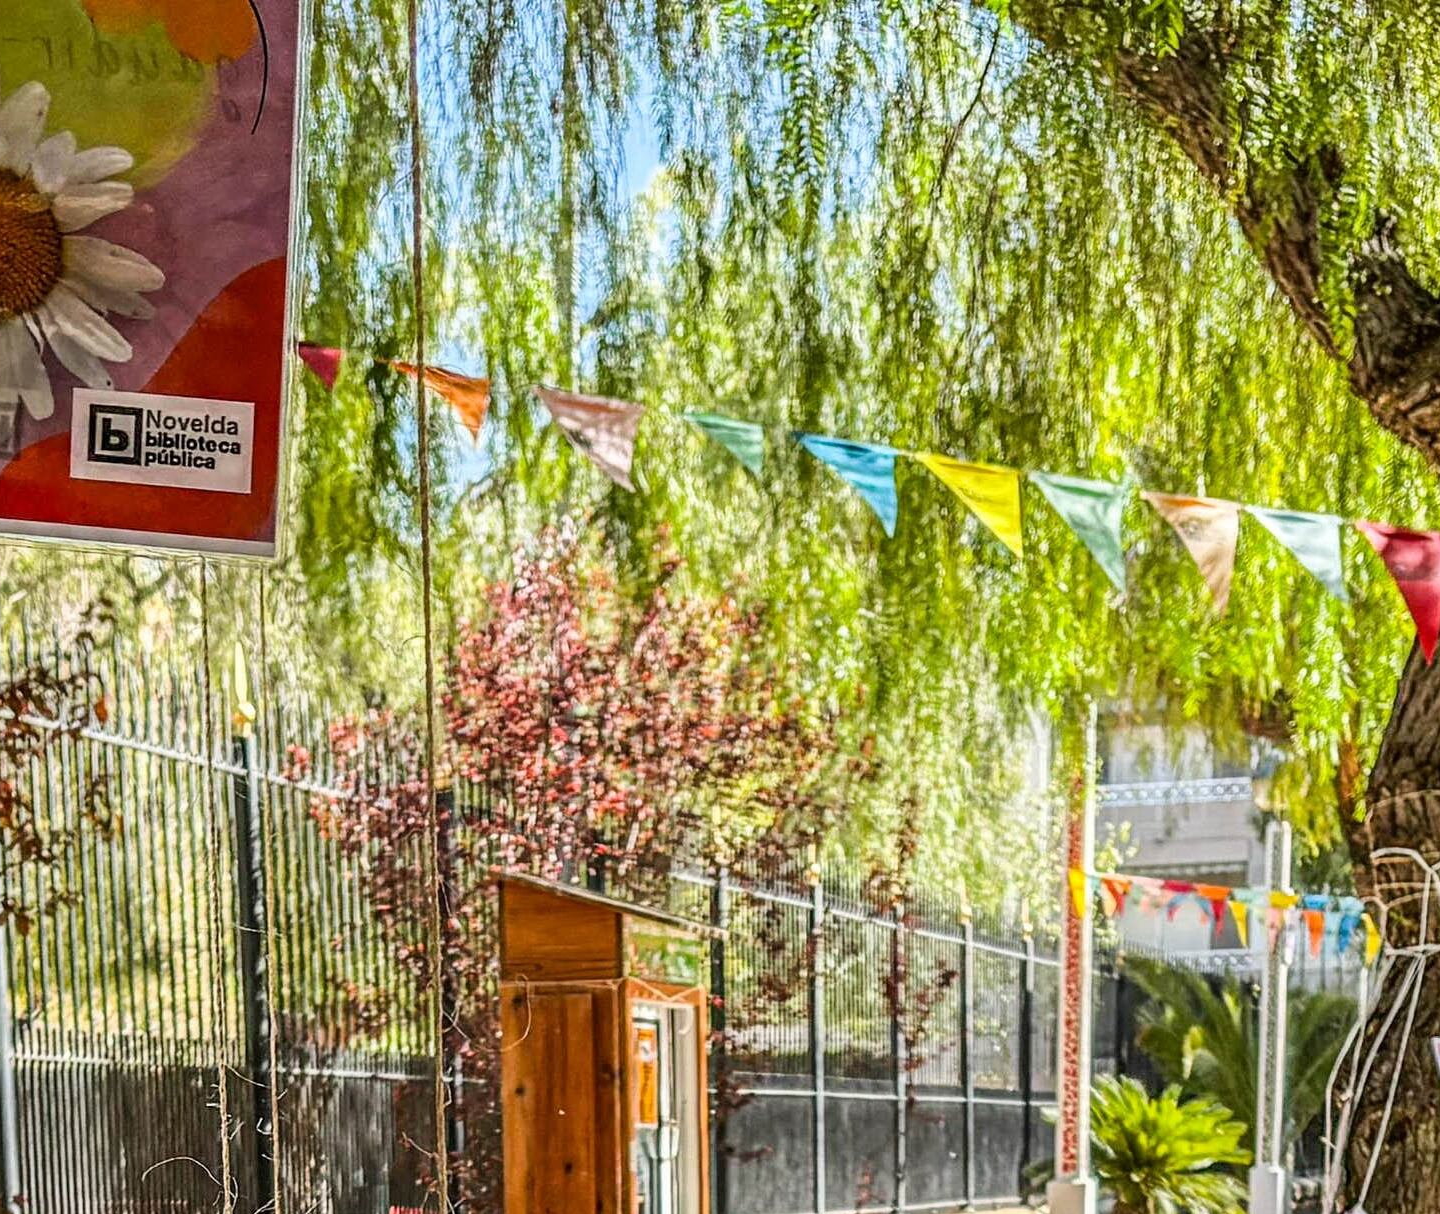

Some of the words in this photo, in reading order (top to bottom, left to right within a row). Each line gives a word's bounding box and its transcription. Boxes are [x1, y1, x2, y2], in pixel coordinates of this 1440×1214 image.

[145, 410, 239, 435] Novelda
[145, 433, 242, 455] biblioteca
[144, 449, 217, 471] pública
